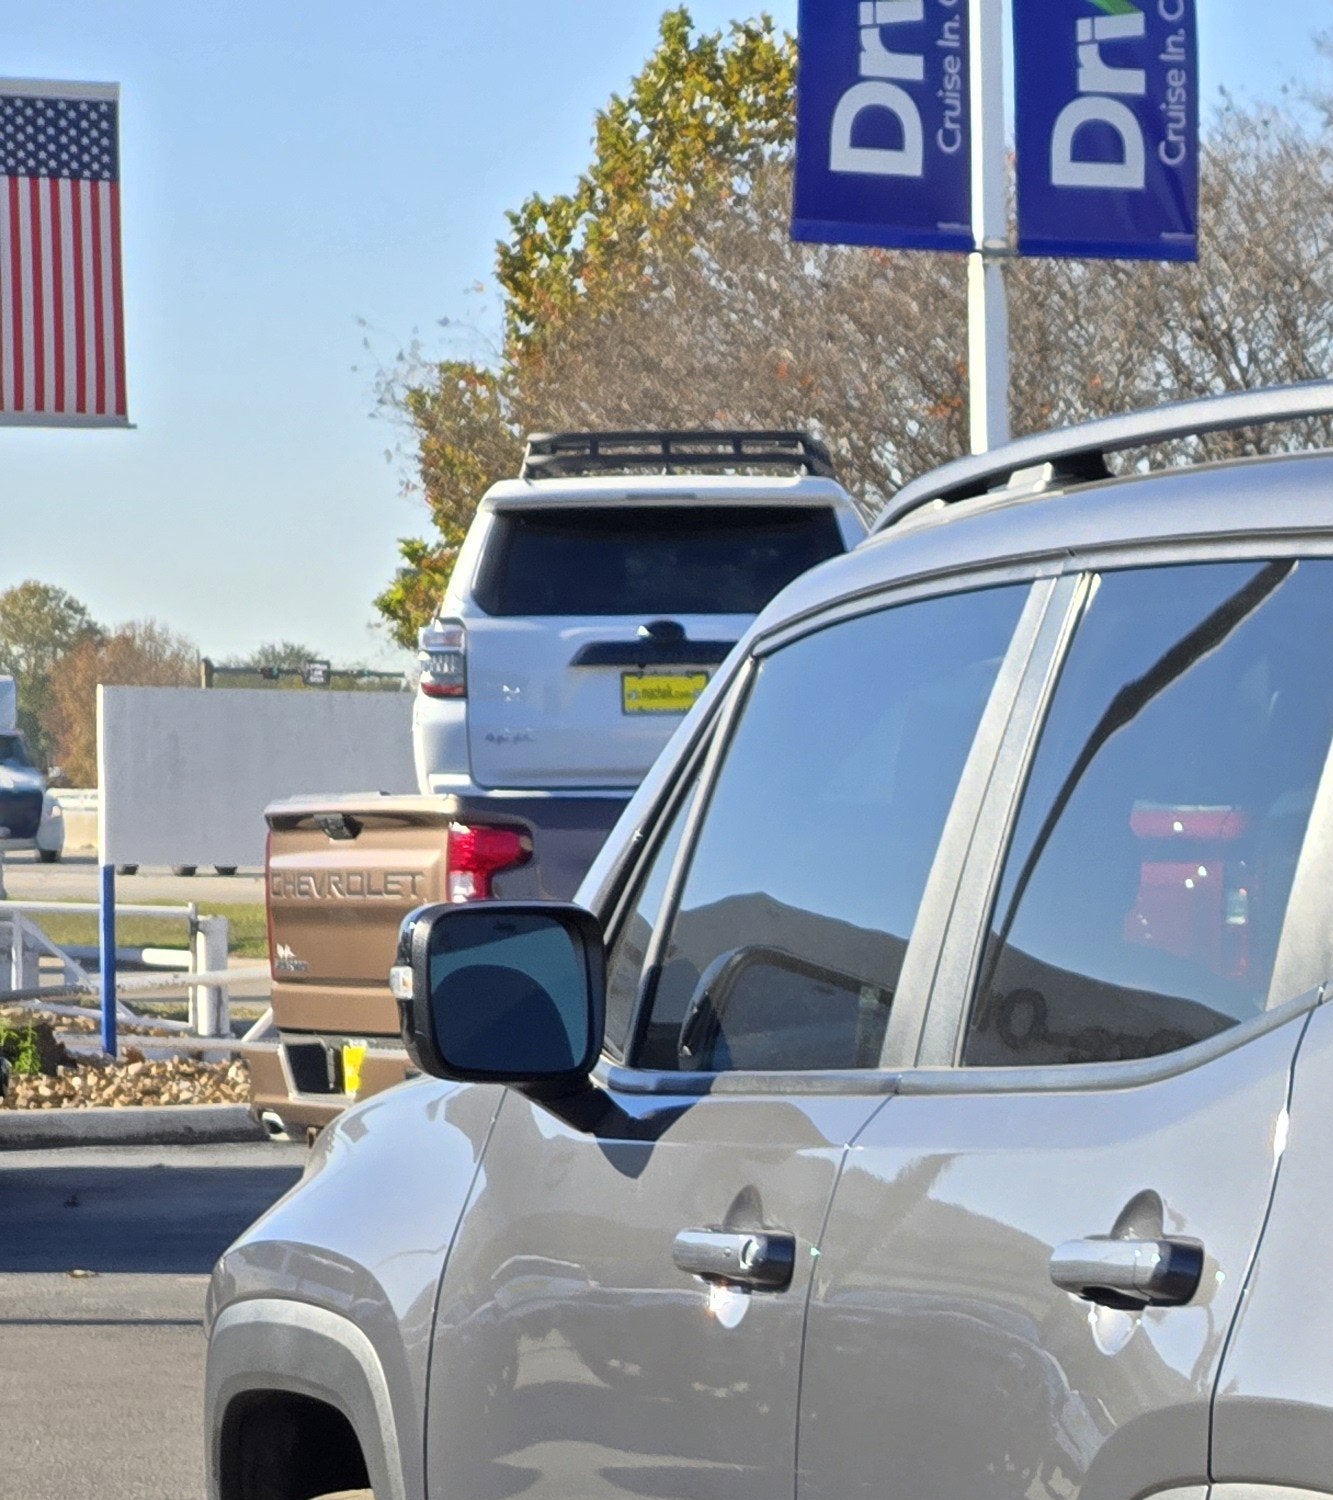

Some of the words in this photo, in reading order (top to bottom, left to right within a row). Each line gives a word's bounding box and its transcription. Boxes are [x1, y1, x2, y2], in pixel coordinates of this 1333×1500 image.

[936, 14, 960, 47] In.
[1158, 28, 1186, 61] In.
[936, 54, 962, 156] Cruise
[1157, 69, 1187, 166] Cruise
[270, 871, 425, 900] CHEVROLET
